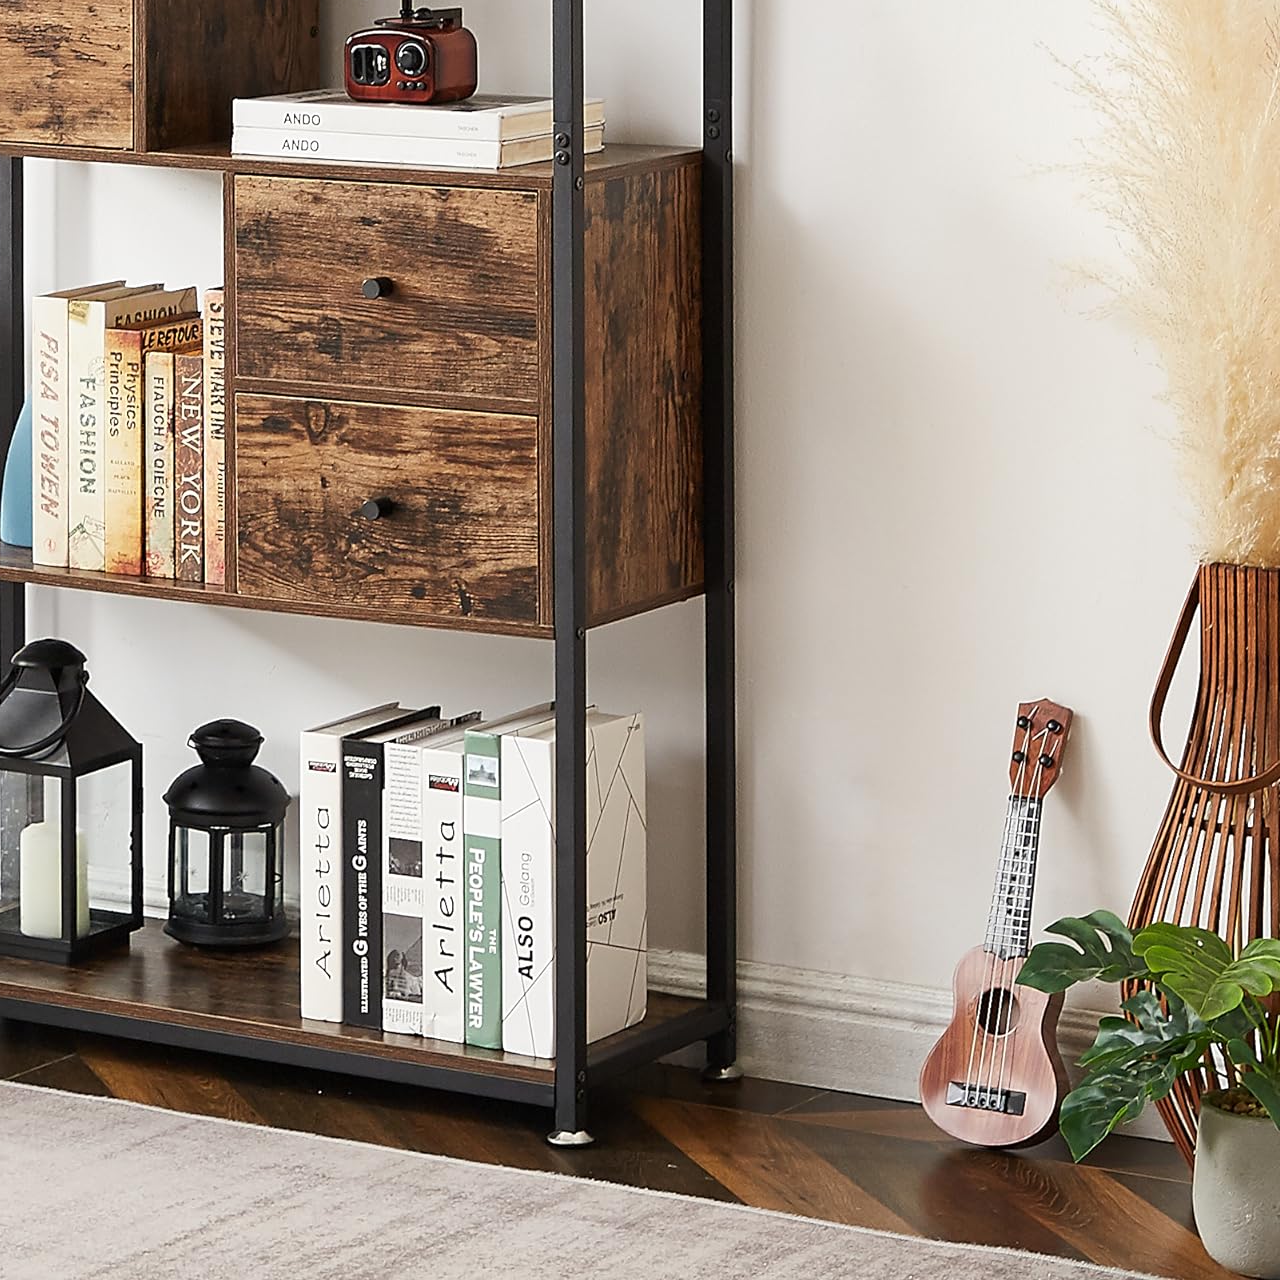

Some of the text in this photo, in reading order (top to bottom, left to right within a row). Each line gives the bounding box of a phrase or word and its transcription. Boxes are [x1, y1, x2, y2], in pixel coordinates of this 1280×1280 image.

[281, 138, 320, 152] ANDO
[283, 112, 322, 126] ANDO
[39, 330, 59, 401] PISA
[143, 324, 199, 348] LE RETOUR
[109, 351, 123, 437] Principles
[126, 362, 140, 431] Physics
[79, 377, 97, 495] FASHION
[152, 442, 164, 453] A
[181, 375, 202, 565] NEW YORK
[315, 807, 332, 979] Arletta
[358, 872, 367, 894] THE
[358, 894, 368, 910] OF
[433, 821, 456, 993] Arletta
[517, 852, 534, 980] ALSO Gelang
[598, 909, 617, 925] ALSO
[469, 847, 486, 1029] PEOPLE'S LAWYER
[488, 928, 497, 955] THE
